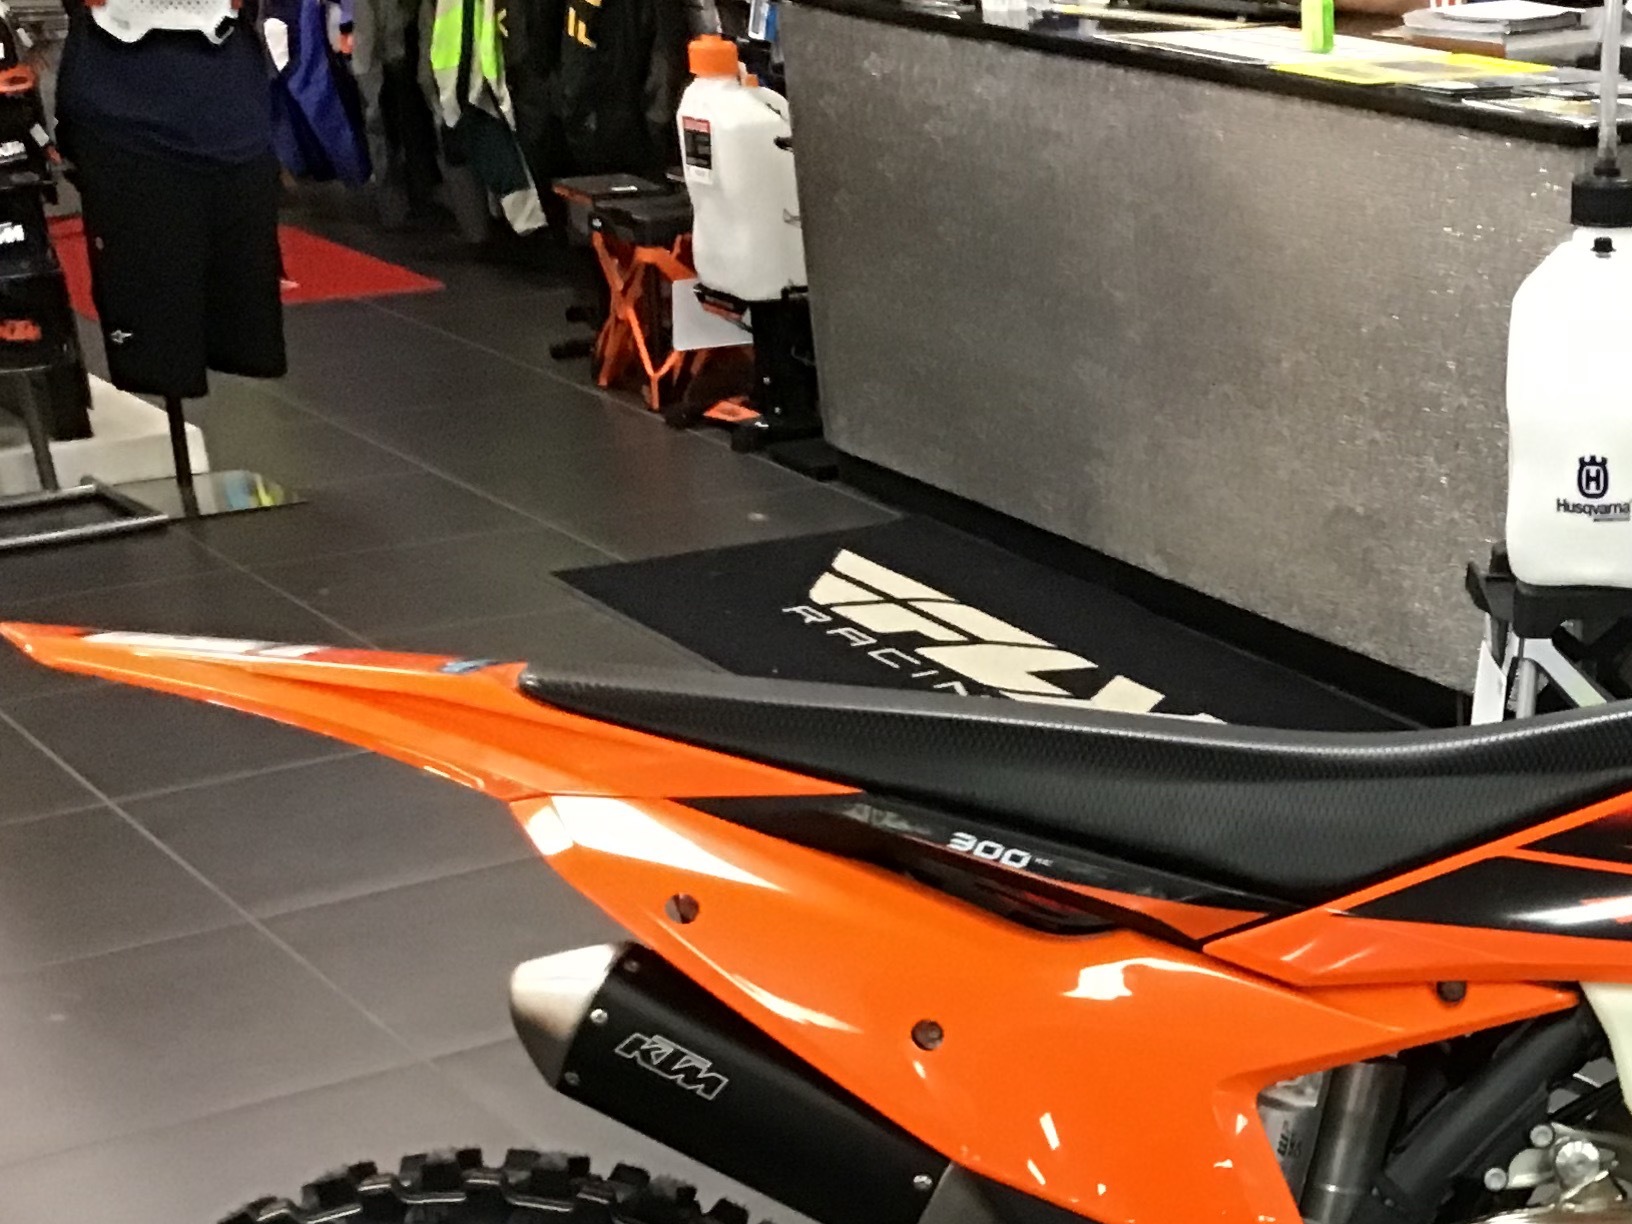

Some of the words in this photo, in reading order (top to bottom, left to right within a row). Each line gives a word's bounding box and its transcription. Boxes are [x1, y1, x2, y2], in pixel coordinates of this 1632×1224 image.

[1556, 498, 1631, 516] Husqvarna
[947, 832, 1033, 869] 300
[614, 1032, 729, 1100] KTM
